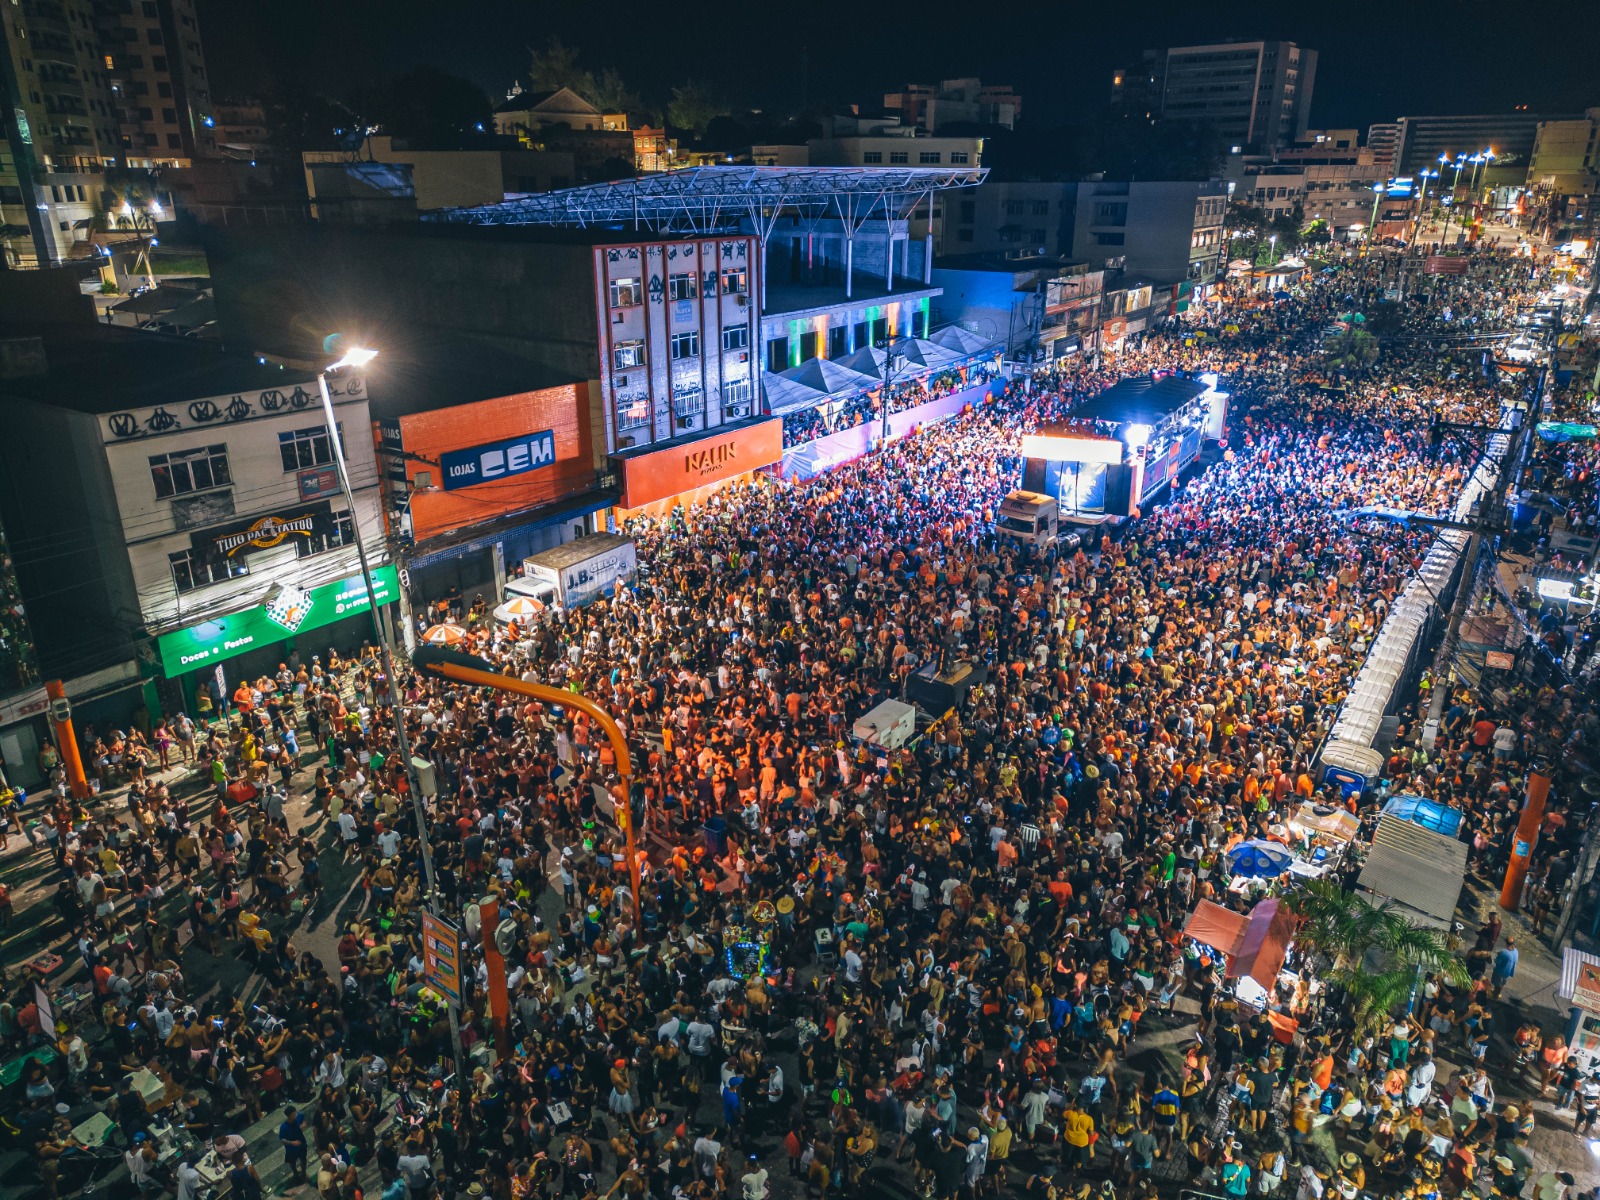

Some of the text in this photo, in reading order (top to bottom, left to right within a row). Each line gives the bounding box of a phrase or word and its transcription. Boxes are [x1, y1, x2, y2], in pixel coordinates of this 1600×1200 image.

[450, 437, 552, 477] LOJAS CEM
[685, 441, 736, 473] NALIN
[247, 528, 268, 540] PAC
[275, 517, 313, 533] TATTOO
[180, 635, 253, 665] Doces e Festas
